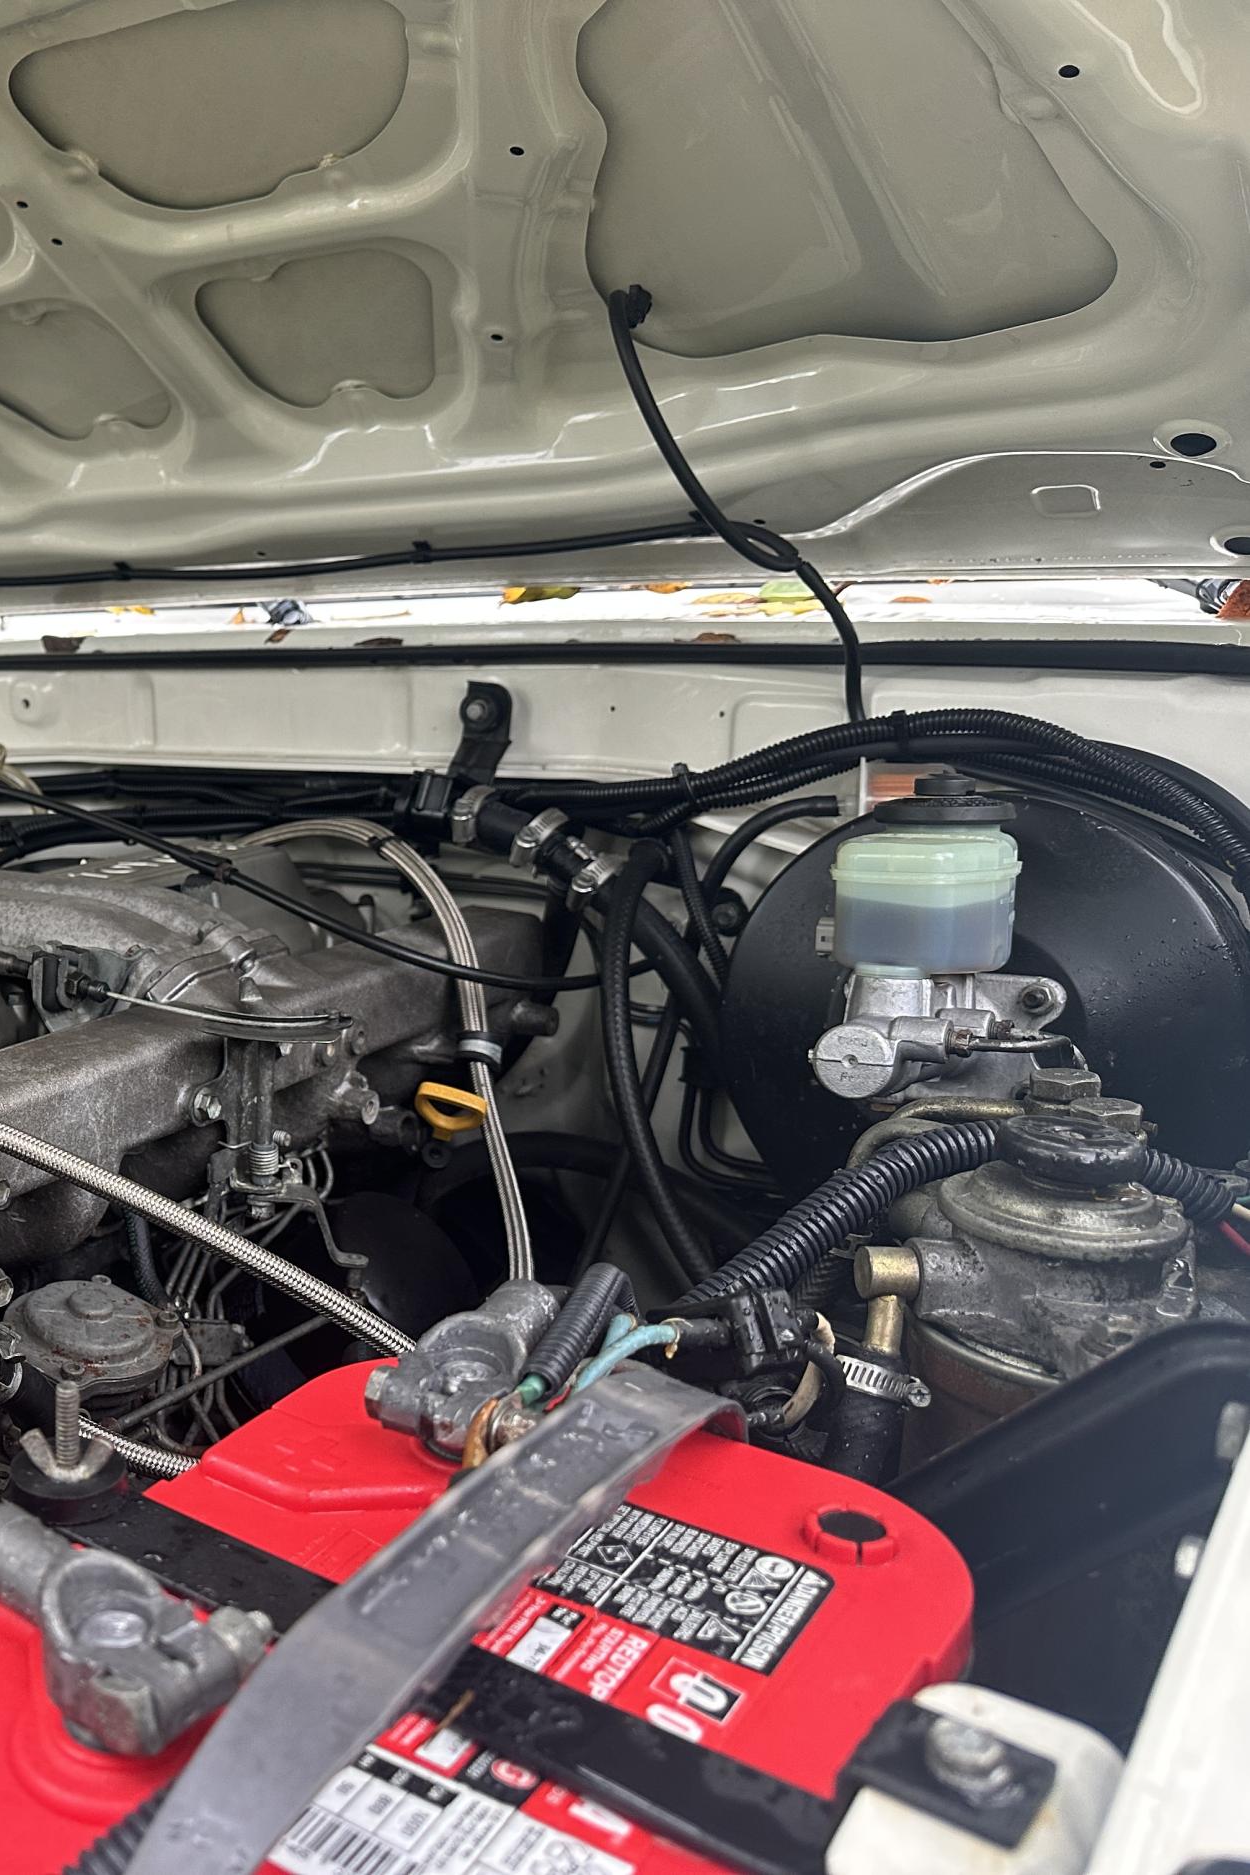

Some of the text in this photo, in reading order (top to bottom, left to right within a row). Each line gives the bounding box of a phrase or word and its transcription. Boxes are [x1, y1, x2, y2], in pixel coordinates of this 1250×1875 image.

[576, 1625, 627, 1673] STARTING
[739, 1580, 818, 1671] DANGER/POISON
[577, 1632, 652, 1703] REDTOP
